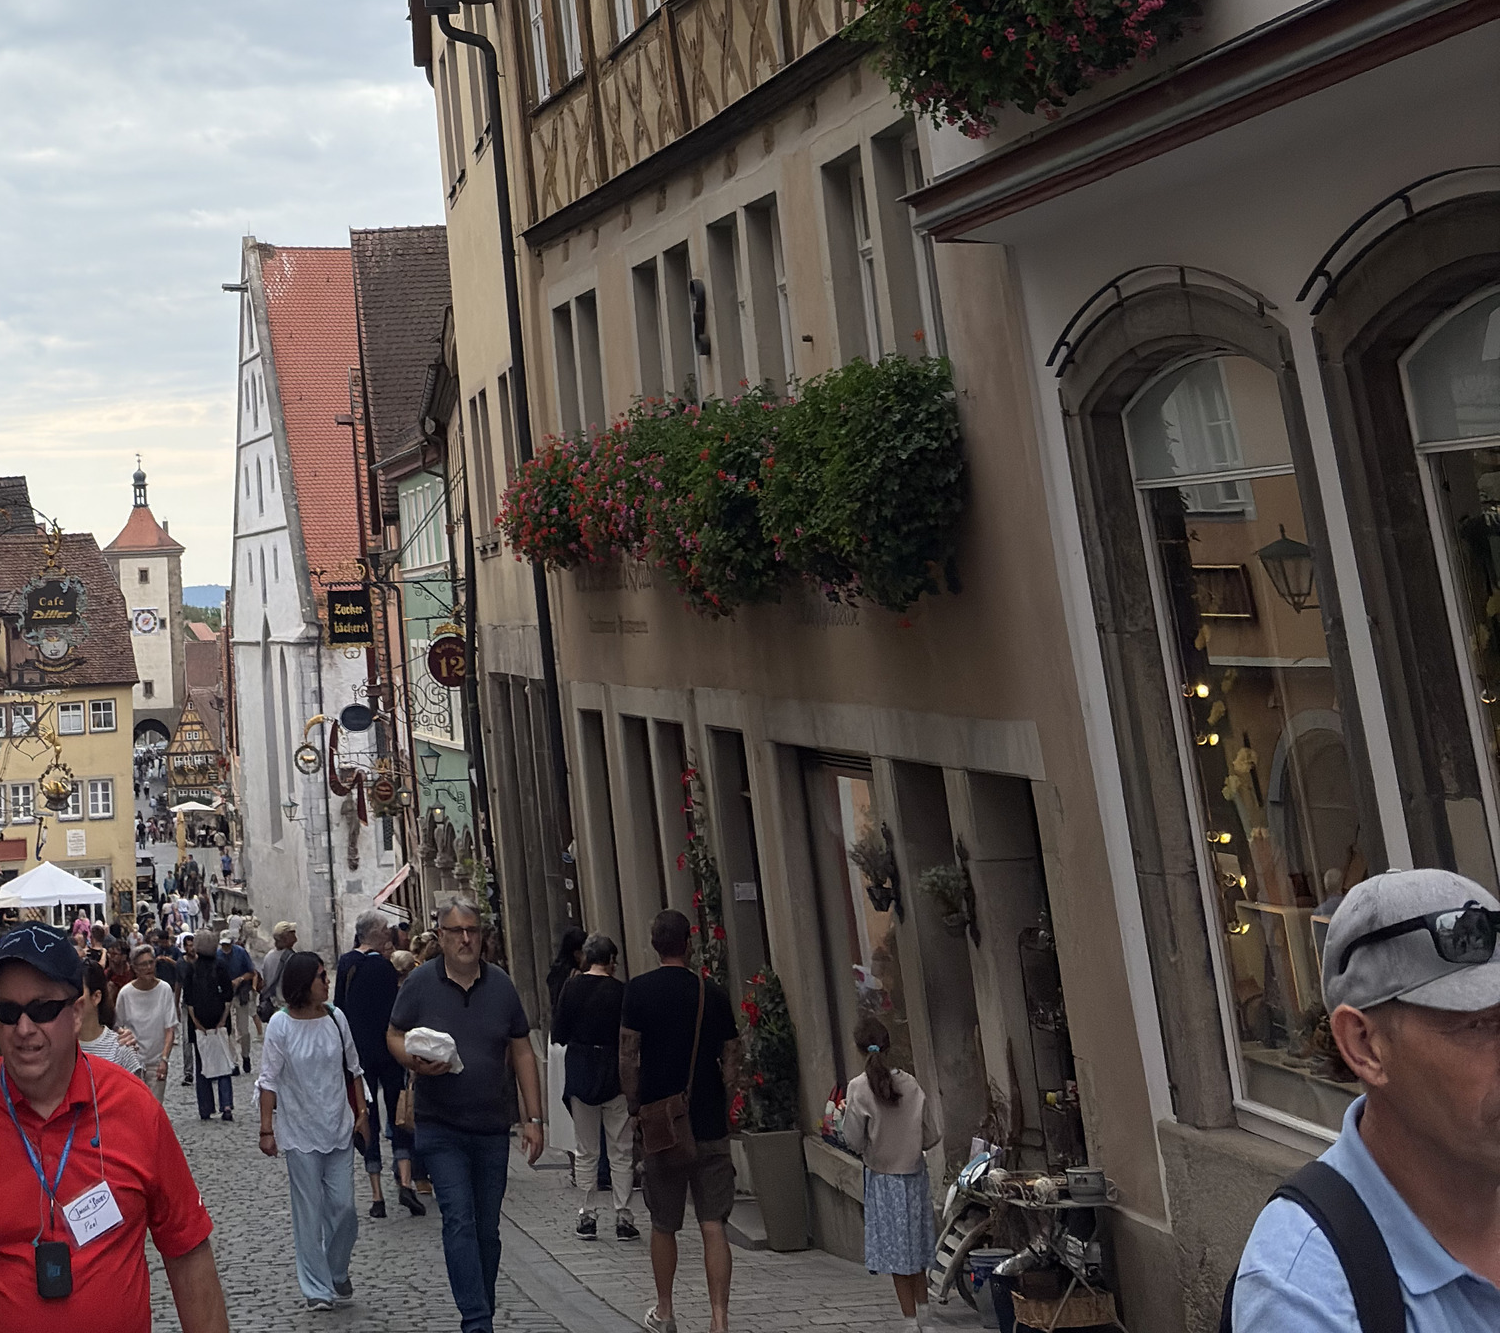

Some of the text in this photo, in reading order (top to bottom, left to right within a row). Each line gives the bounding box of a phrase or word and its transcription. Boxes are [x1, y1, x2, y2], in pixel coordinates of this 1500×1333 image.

[38, 596, 65, 607] Cafe
[31, 609, 73, 620] Diller
[438, 655, 467, 679] 12
